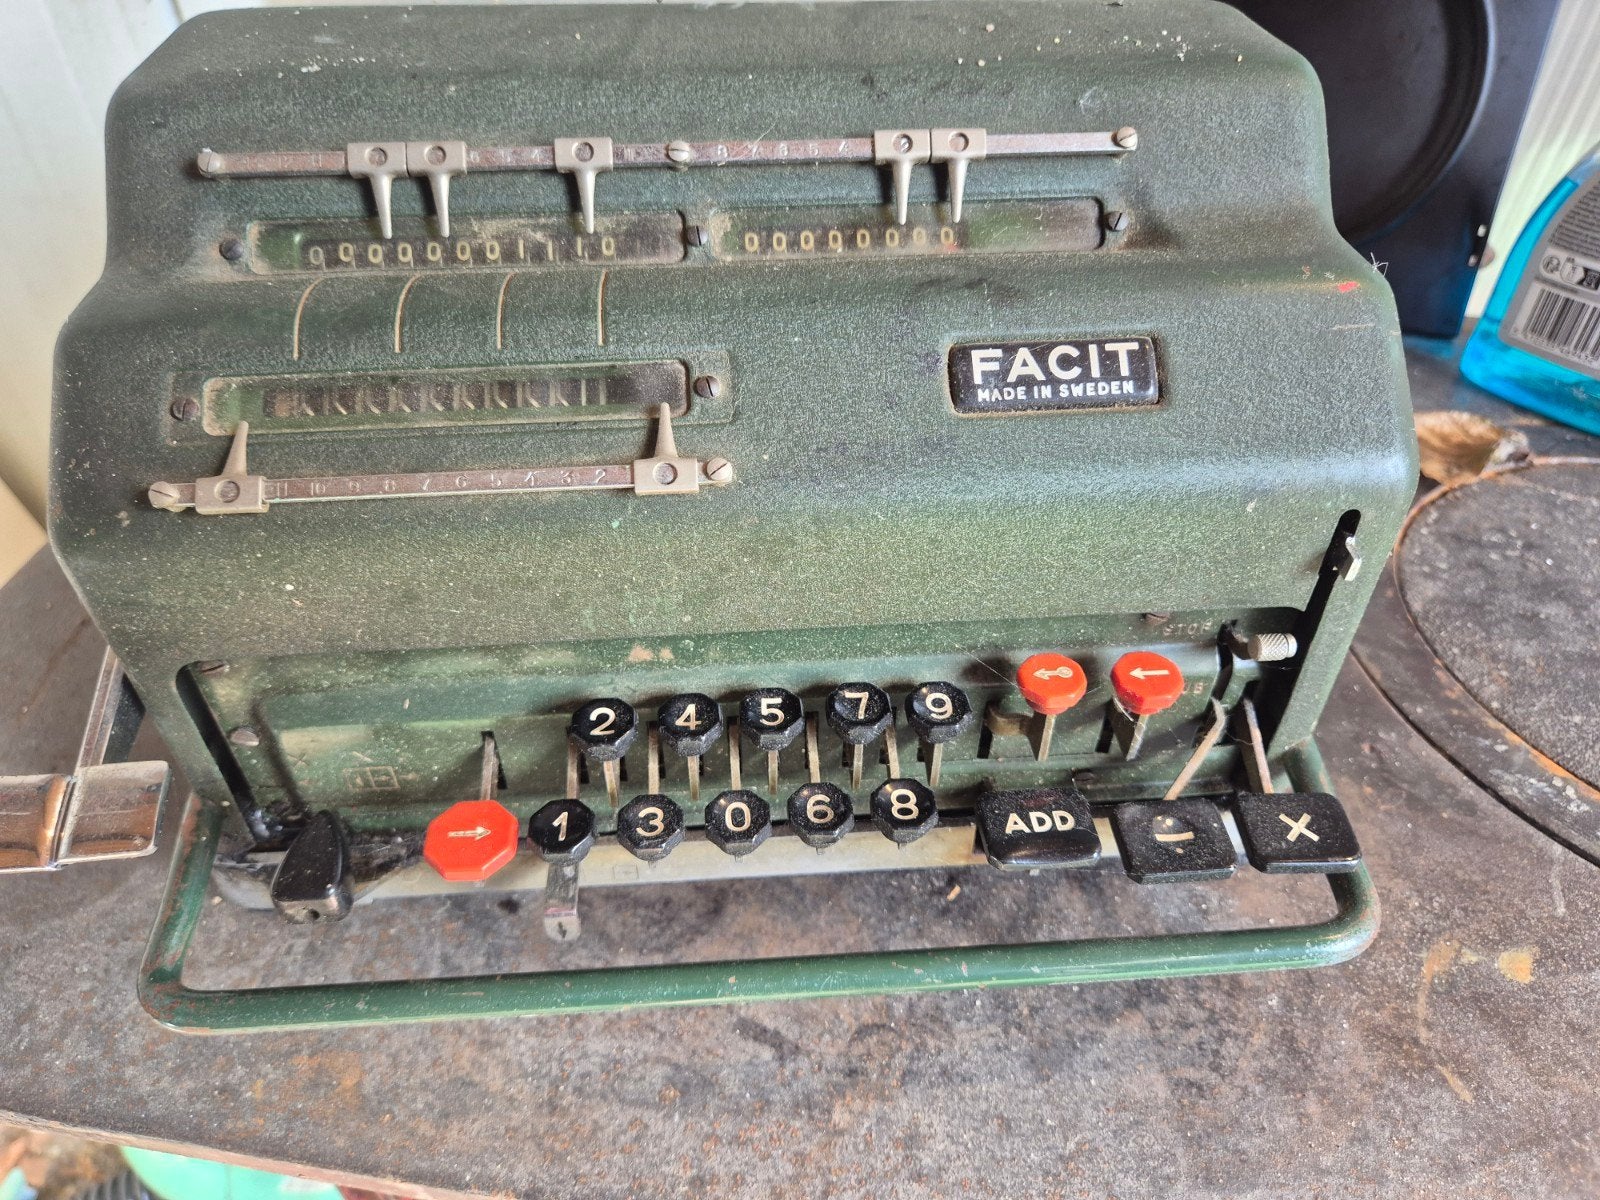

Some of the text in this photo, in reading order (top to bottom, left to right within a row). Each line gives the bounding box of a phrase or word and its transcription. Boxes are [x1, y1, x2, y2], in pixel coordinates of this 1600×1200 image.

[971, 342, 1140, 385] FACIT
[977, 380, 1135, 403] MADE IN SWEDEN
[675, 704, 702, 731] 4
[759, 698, 785, 726] 5
[844, 691, 869, 720] 7
[925, 692, 953, 720] 9
[589, 707, 616, 735] 2
[725, 801, 751, 832] 0
[806, 794, 835, 824] 6
[890, 788, 919, 820] 8
[552, 811, 569, 841] 1
[636, 806, 664, 837] 3
[1004, 809, 1076, 835] ADD
